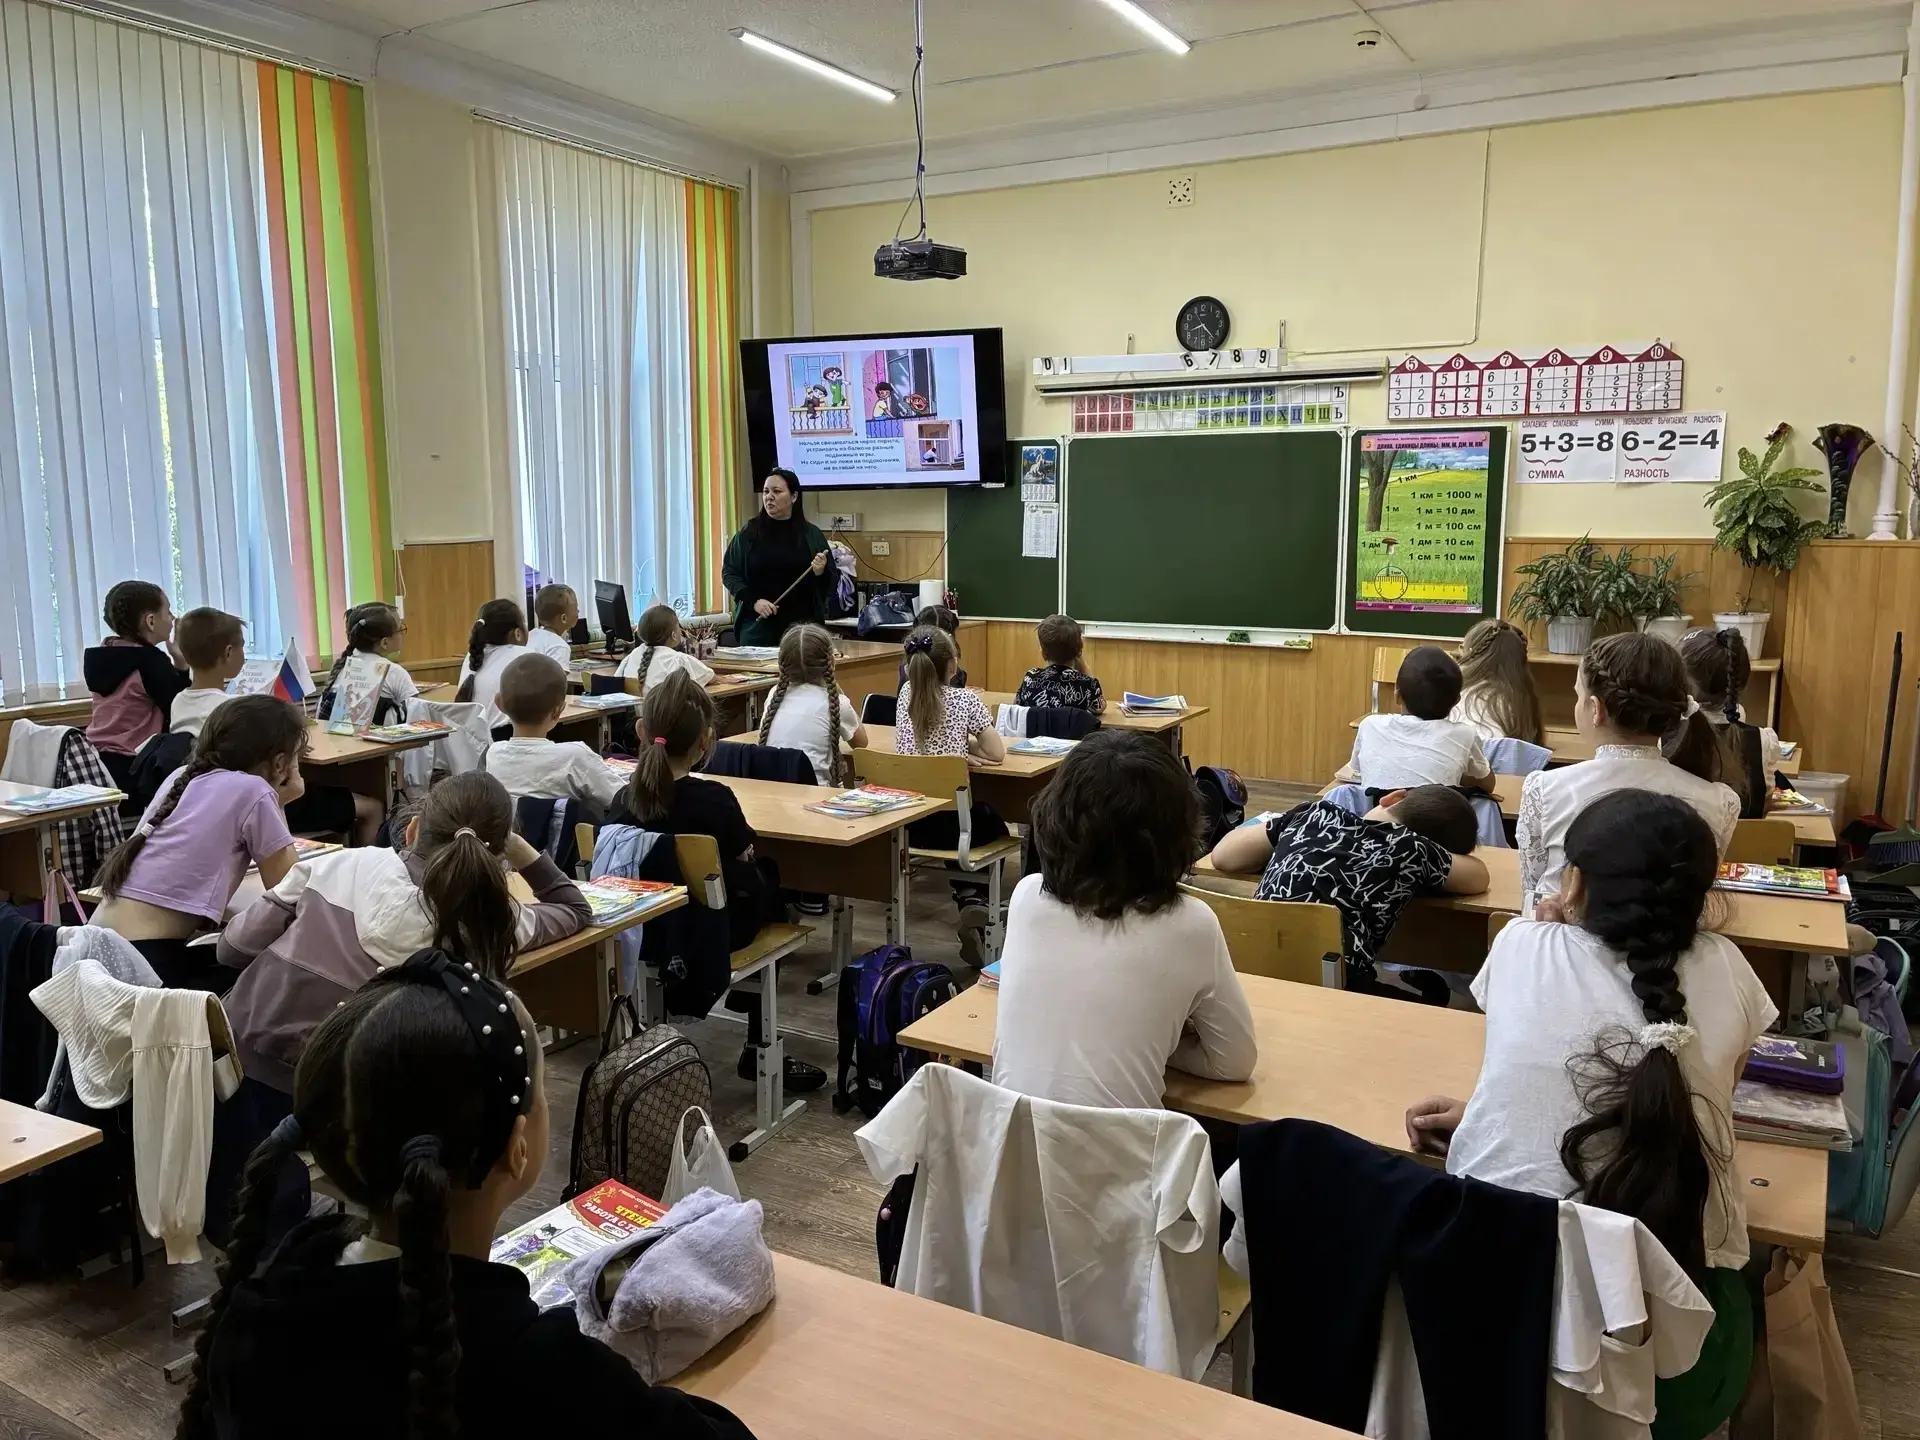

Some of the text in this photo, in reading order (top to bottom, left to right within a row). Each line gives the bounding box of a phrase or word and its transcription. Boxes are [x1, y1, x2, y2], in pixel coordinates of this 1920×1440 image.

[1602, 351, 1609, 360] 9
[1652, 347, 1662, 358] 10
[1044, 350, 1267, 370] 0 1 6 7 8 9
[1454, 358, 1460, 368] 6
[1503, 356, 1509, 365] 7
[1551, 353, 1558, 364] 8
[1409, 359, 1416, 370] 5
[1638, 361, 1671, 371] 9 1
[1538, 367, 1568, 377] 7 1
[1588, 365, 1618, 375] 8 1
[1395, 373, 1424, 386] 4 1
[1441, 372, 1470, 385] 5 1
[1488, 370, 1518, 382] 6 1
[1587, 376, 1619, 386] 7 2
[1637, 371, 1671, 382] 8 2
[1537, 379, 1568, 389] 6 2
[1637, 381, 1670, 392] 7 3
[1395, 389, 1424, 401] 3 2
[1440, 387, 1471, 400] 4 2
[1487, 385, 1519, 398] 5 2
[1536, 390, 1568, 400] 5 3
[1586, 388, 1618, 398] 6 3
[1636, 391, 1669, 400] 6 4
[1440, 402, 1469, 415] 3 3
[1486, 401, 1518, 412] 4 3
[1535, 402, 1565, 412] 4 4
[1585, 400, 1617, 410] 5 4
[1636, 400, 1669, 409] 5 5
[1394, 404, 1424, 416] 5 0
[1100, 417, 1109, 428] Ю
[1125, 416, 1132, 427] Е
[1212, 414, 1220, 424] Ф
[1226, 413, 1234, 423] К
[1238, 412, 1246, 422] Т
[1250, 411, 1261, 422] Ш
[1265, 411, 1273, 422] С
[1278, 410, 1288, 421] Х
[1292, 410, 1301, 421] Ц
[1306, 409, 1315, 419] Ч
[1319, 408, 1330, 419] Щ
[1335, 408, 1342, 418] Ь
[1658, 416, 1687, 424] ВЫЧИТАЕМОЕ
[1522, 420, 1547, 428] СЛАГАЕМОЕ
[1521, 431, 1613, 453] 5+3=8
[1405, 474, 1417, 482] км
[1528, 470, 1564, 479] СУММА
[1625, 469, 1669, 477] РАЗНОСТЬ
[582, 1202, 619, 1223] РАБОТА
[625, 1223, 640, 1232] ТЕ
[615, 1205, 654, 1228] ЧТЕНИ
